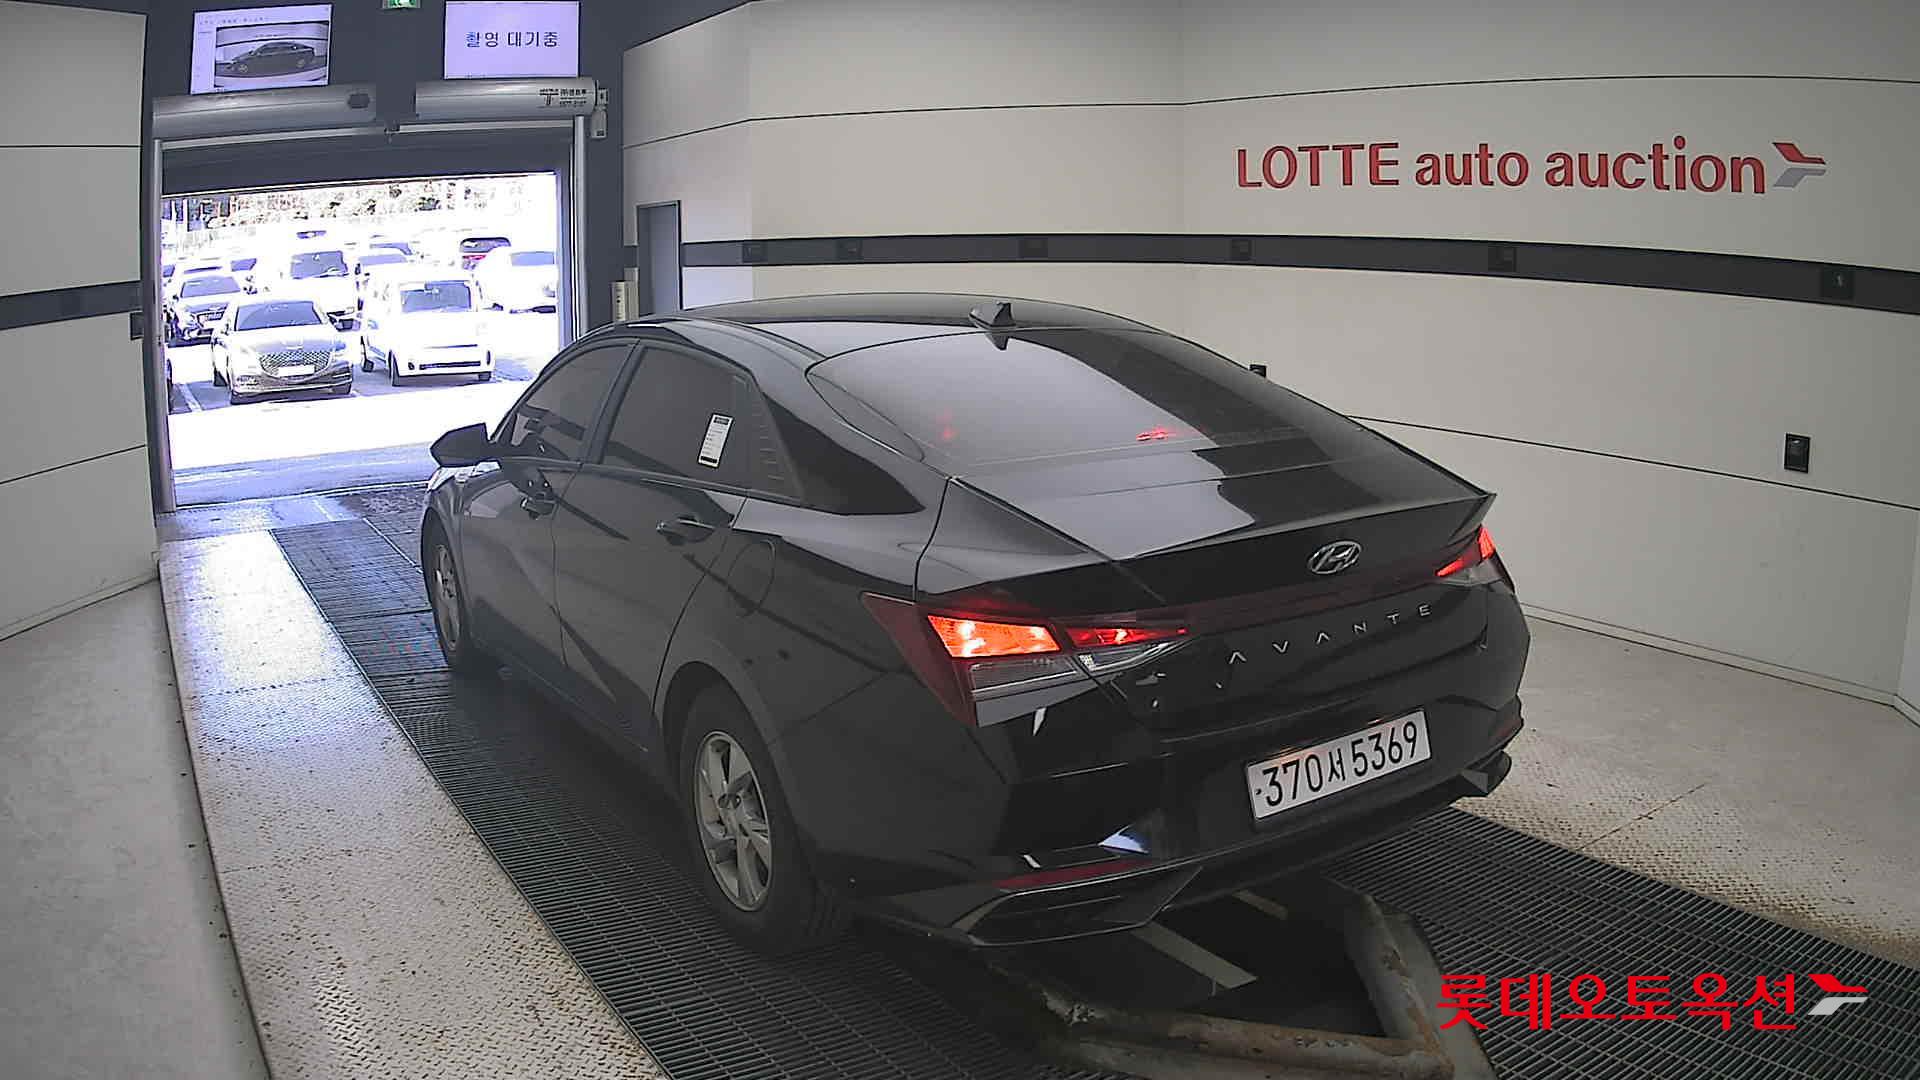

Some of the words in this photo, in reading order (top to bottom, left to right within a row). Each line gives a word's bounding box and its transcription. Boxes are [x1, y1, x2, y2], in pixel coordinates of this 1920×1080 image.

[507, 31, 559, 48] 대기중
[1237, 142, 1400, 188] LOTTE
[1415, 143, 1529, 187] auto
[1545, 135, 1766, 194] auction
[1228, 603, 1433, 665] AVANTE
[1351, 720, 1418, 777] 5369
